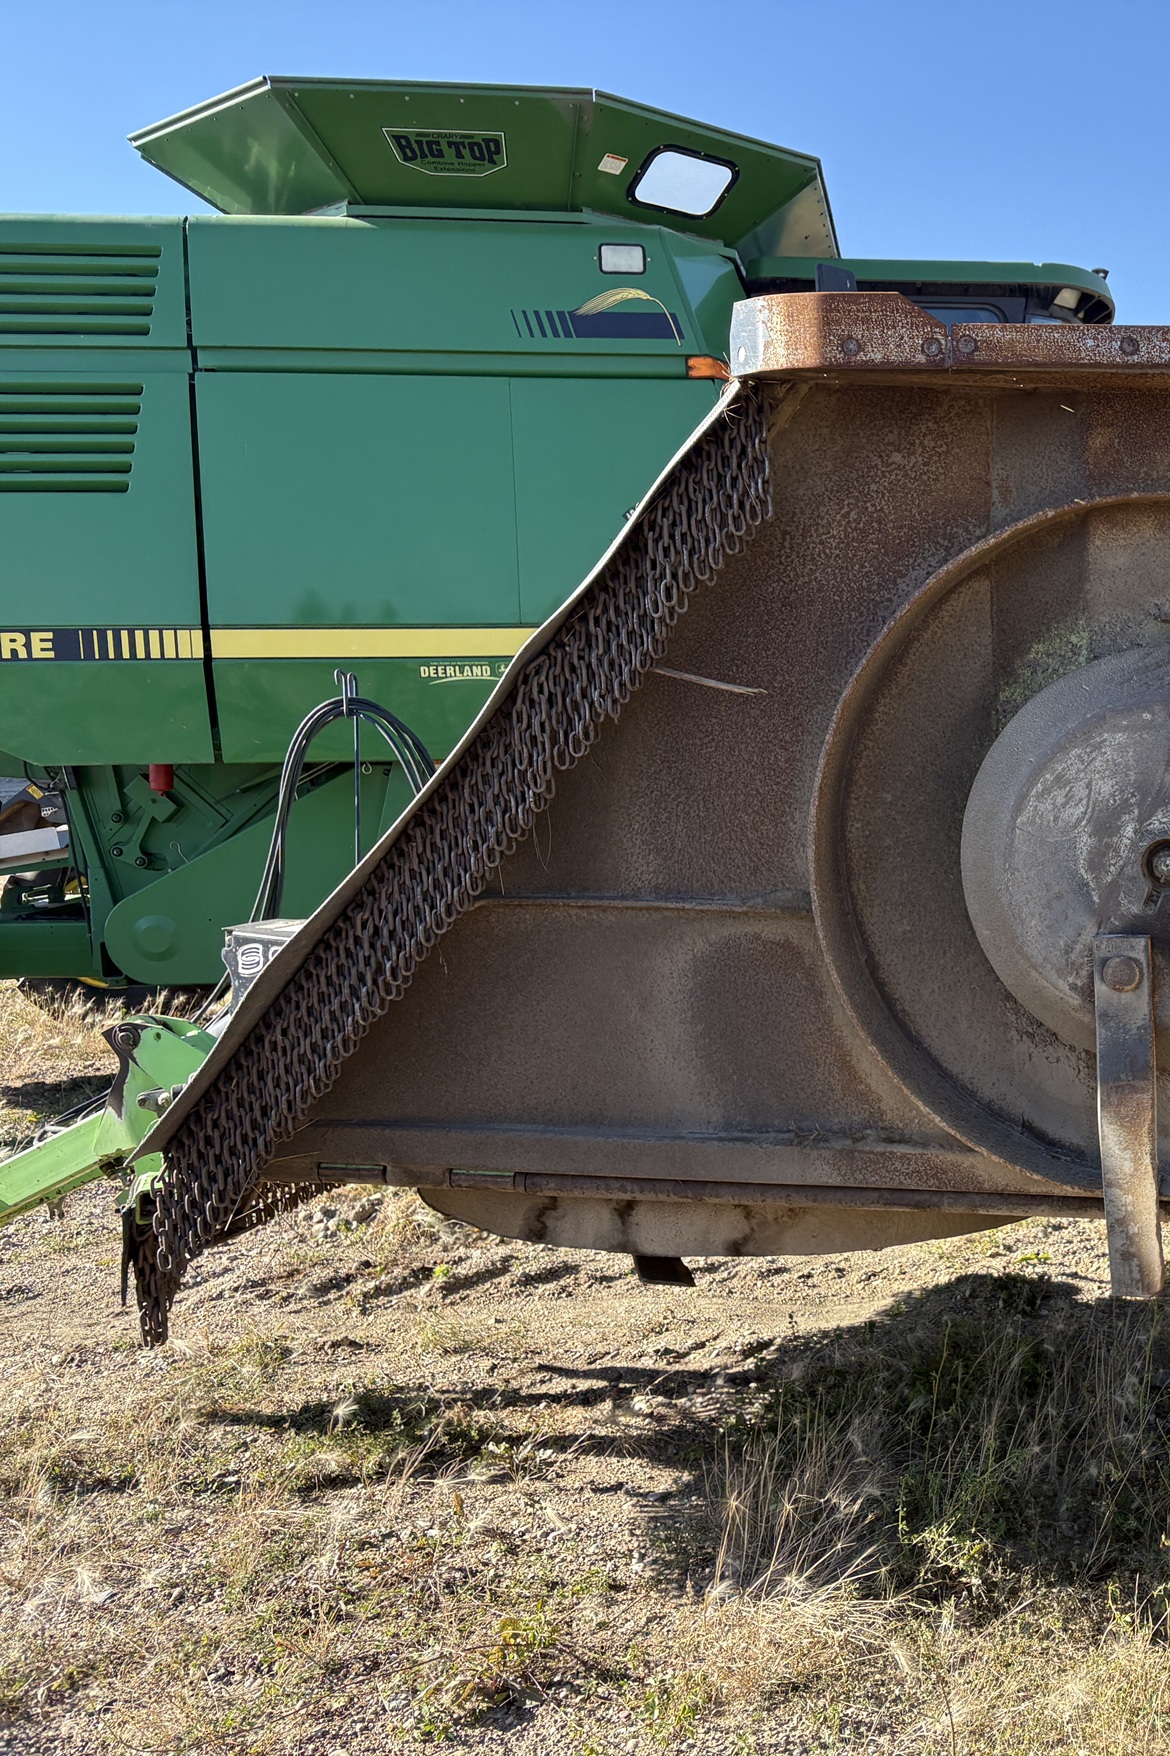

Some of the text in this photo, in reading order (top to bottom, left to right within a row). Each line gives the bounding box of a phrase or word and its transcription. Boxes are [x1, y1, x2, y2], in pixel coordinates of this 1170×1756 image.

[391, 134, 501, 165] BIG TOP
[0, 631, 55, 659] RE
[420, 665, 491, 678] DEERLAND
